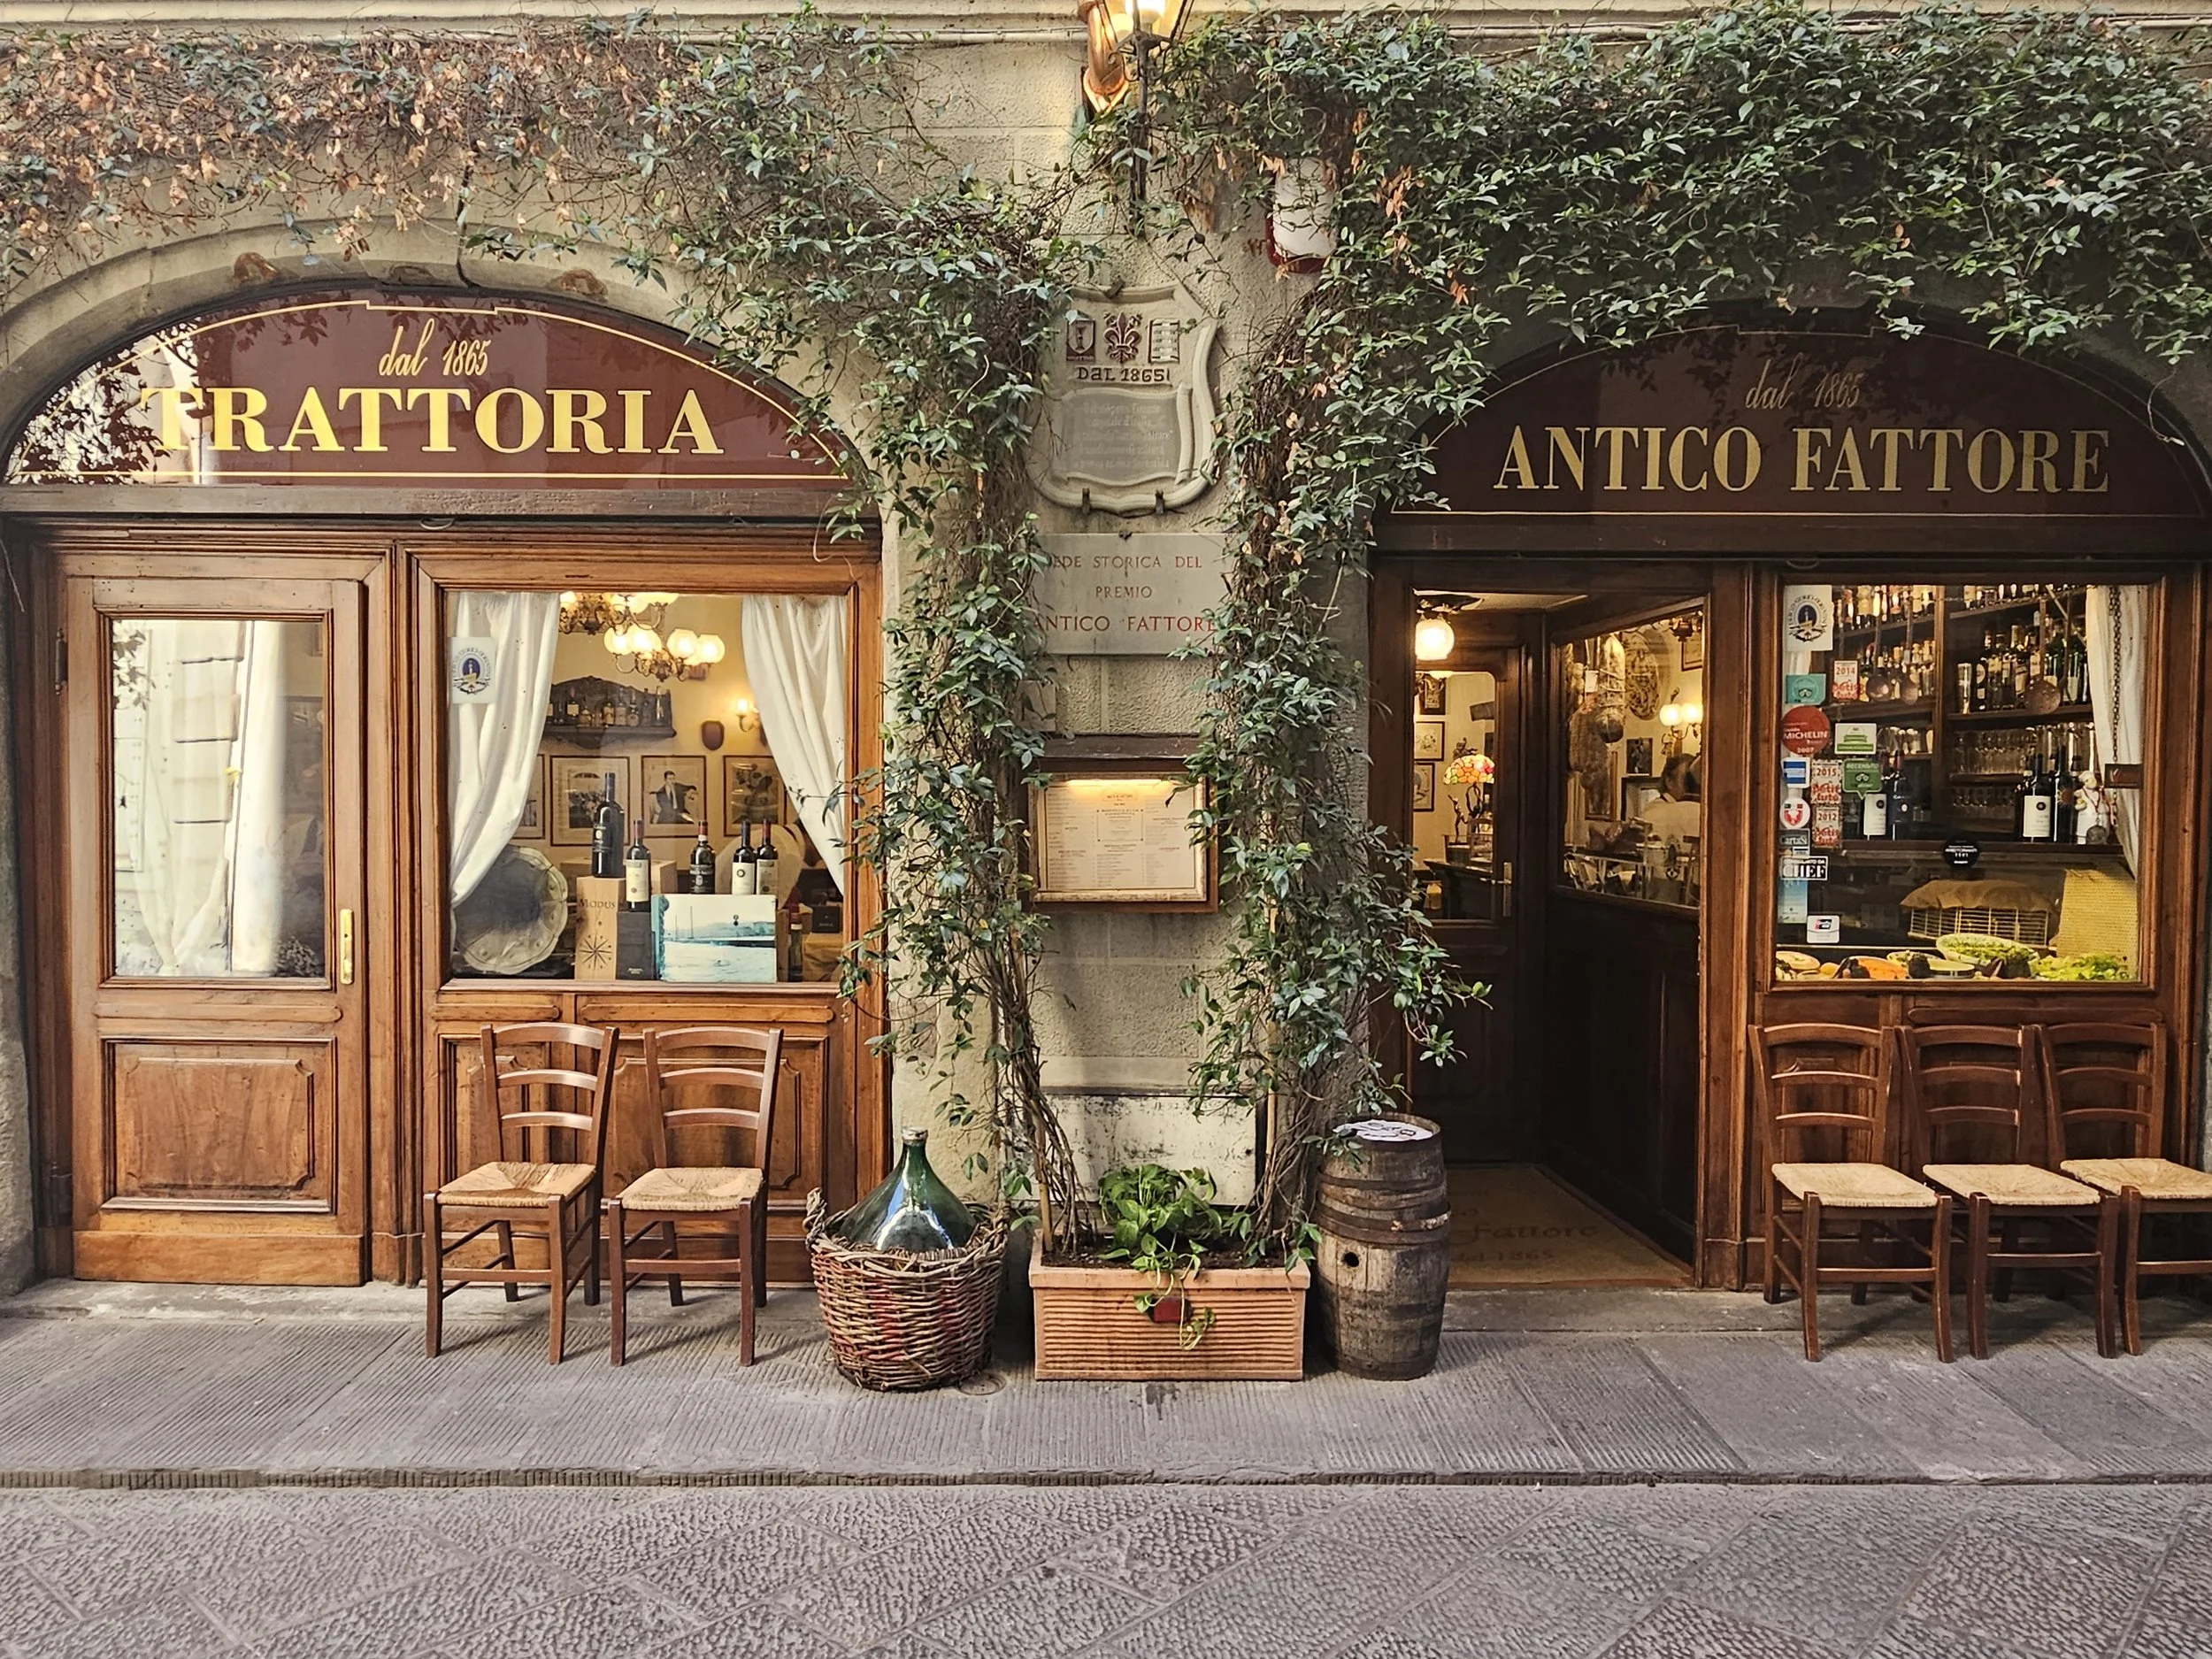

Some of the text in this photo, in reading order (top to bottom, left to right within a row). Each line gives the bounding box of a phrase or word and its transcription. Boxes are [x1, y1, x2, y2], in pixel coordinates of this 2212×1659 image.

[378, 318, 493, 378] dal 1865
[1120, 367, 1165, 382] 1865
[1745, 359, 1866, 411] dal 1865
[142, 386, 725, 455] TRATTORIA
[1493, 426, 2109, 494] ANTICO FATTORE
[1093, 555, 1162, 569] STORICA
[1175, 556, 1202, 568] DEL
[1095, 586, 1153, 599] PREMIO
[1836, 666, 1855, 675] 2014
[1783, 730, 1829, 740] MICHELIN
[1816, 767, 1837, 777] 2015
[1817, 812, 1838, 821] 2012
[578, 899, 617, 910] MODUS
[1497, 1248, 1555, 1262] 1865
